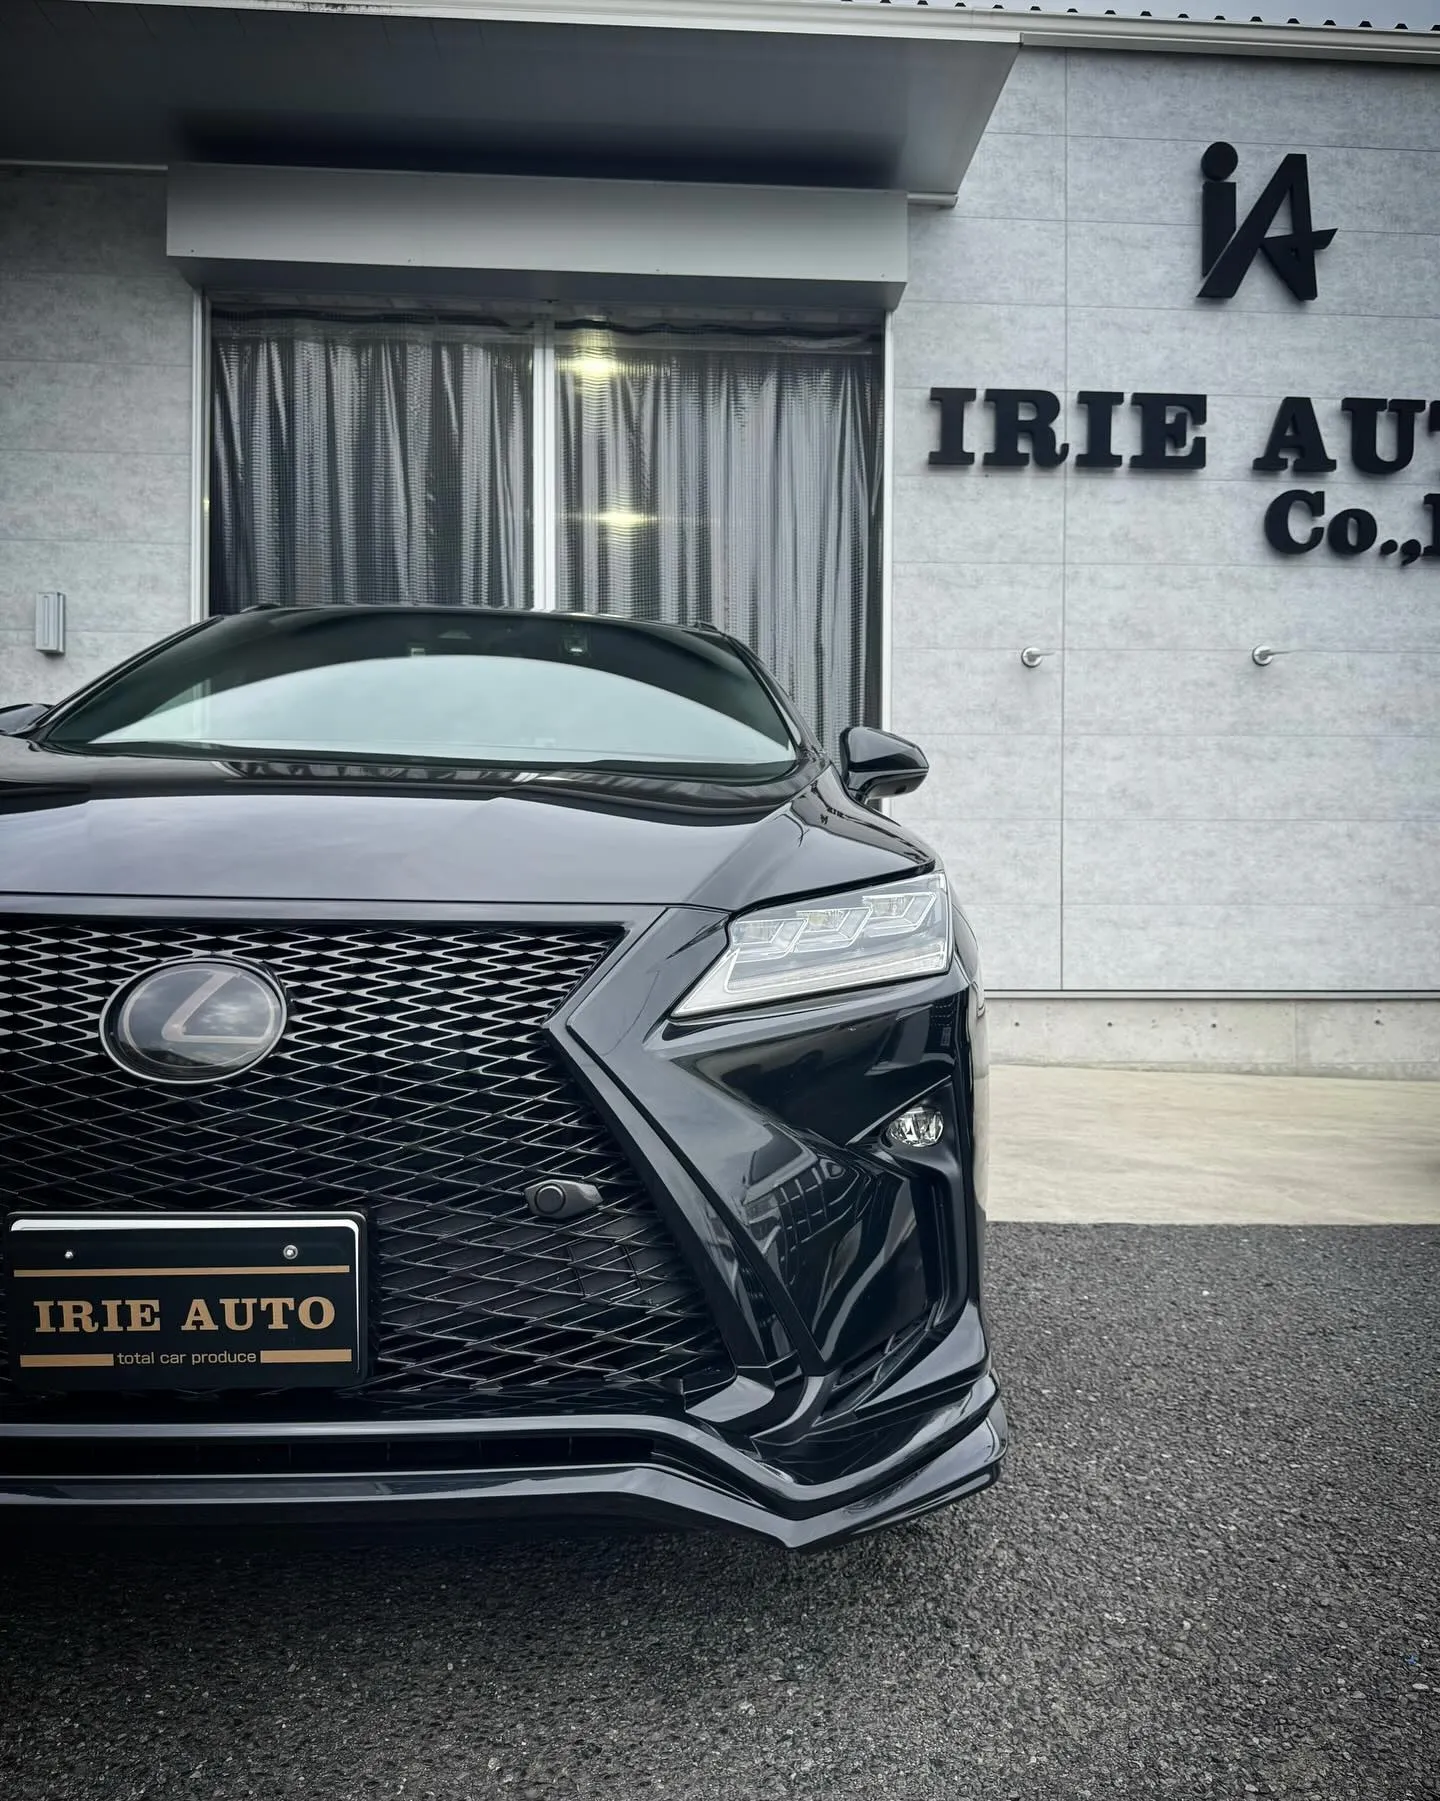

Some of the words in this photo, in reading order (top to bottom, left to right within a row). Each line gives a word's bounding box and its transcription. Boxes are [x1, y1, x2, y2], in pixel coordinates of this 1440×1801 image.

[928, 387, 1207, 470] IRIE
[1252, 396, 1440, 475] AU
[33, 1300, 161, 1333] IRIE
[181, 1296, 336, 1331] AUTO
[117, 1350, 155, 1365] total
[160, 1352, 187, 1365] car
[191, 1350, 257, 1366] produce
